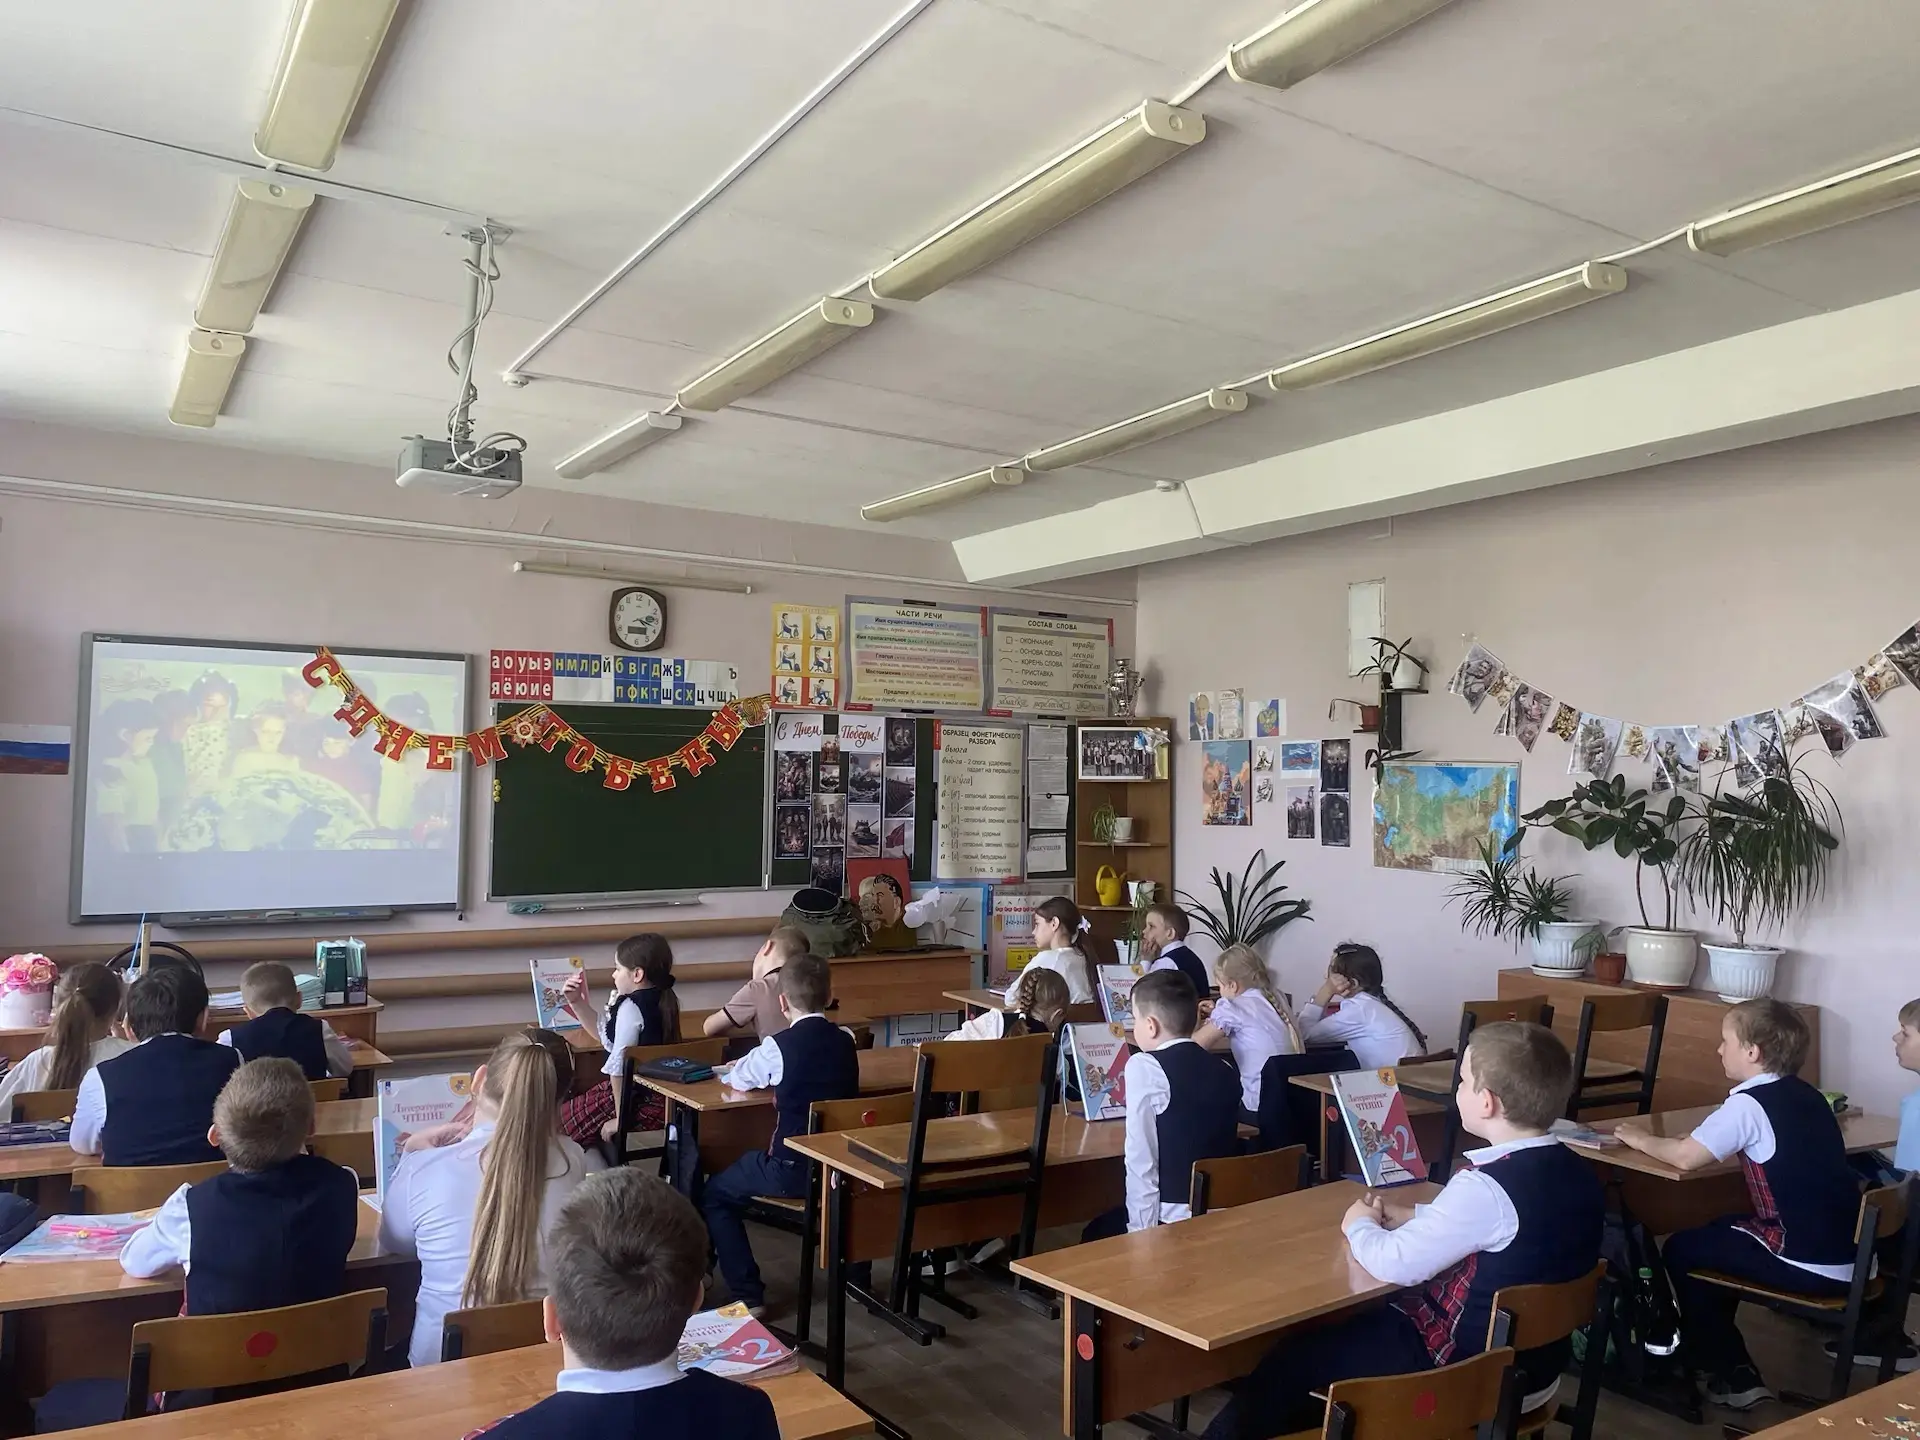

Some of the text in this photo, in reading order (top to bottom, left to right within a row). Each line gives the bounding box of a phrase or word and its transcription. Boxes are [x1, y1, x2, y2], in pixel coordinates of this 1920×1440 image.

[636, 594, 643, 602] 12
[648, 599, 652, 607] 1
[619, 604, 625, 612] 10
[616, 614, 622, 622] 9
[896, 609, 943, 620] ЧАСТИ РЕЧИ
[887, 618, 934, 628] существительное
[1028, 620, 1078, 630] СОСТАВ СЛОВА
[634, 638, 640, 646] 6
[1020, 638, 1054, 646] ОКОНЧАНИЕ
[1020, 648, 1043, 656] ОСНОВА
[876, 653, 894, 662] Глагол
[1021, 658, 1064, 668] КОРЕНЬ СЛОВА
[1022, 668, 1054, 678] ПРИСТАВКА
[884, 688, 909, 696] Предлоги
[777, 721, 882, 748] С Днем Победы!
[942, 729, 1022, 740] ОБРАЗЕЦ ФОНЕТИЧЕСКОГО
[968, 738, 996, 746] РАЗБОРА
[392, 1101, 454, 1114] Литературное
[1356, 1100, 1384, 1111] ЧТЕНИЕ
[402, 1111, 445, 1124] ЧТЕНИЕ
[1394, 1124, 1417, 1161] 2
[741, 1338, 782, 1361] 2
